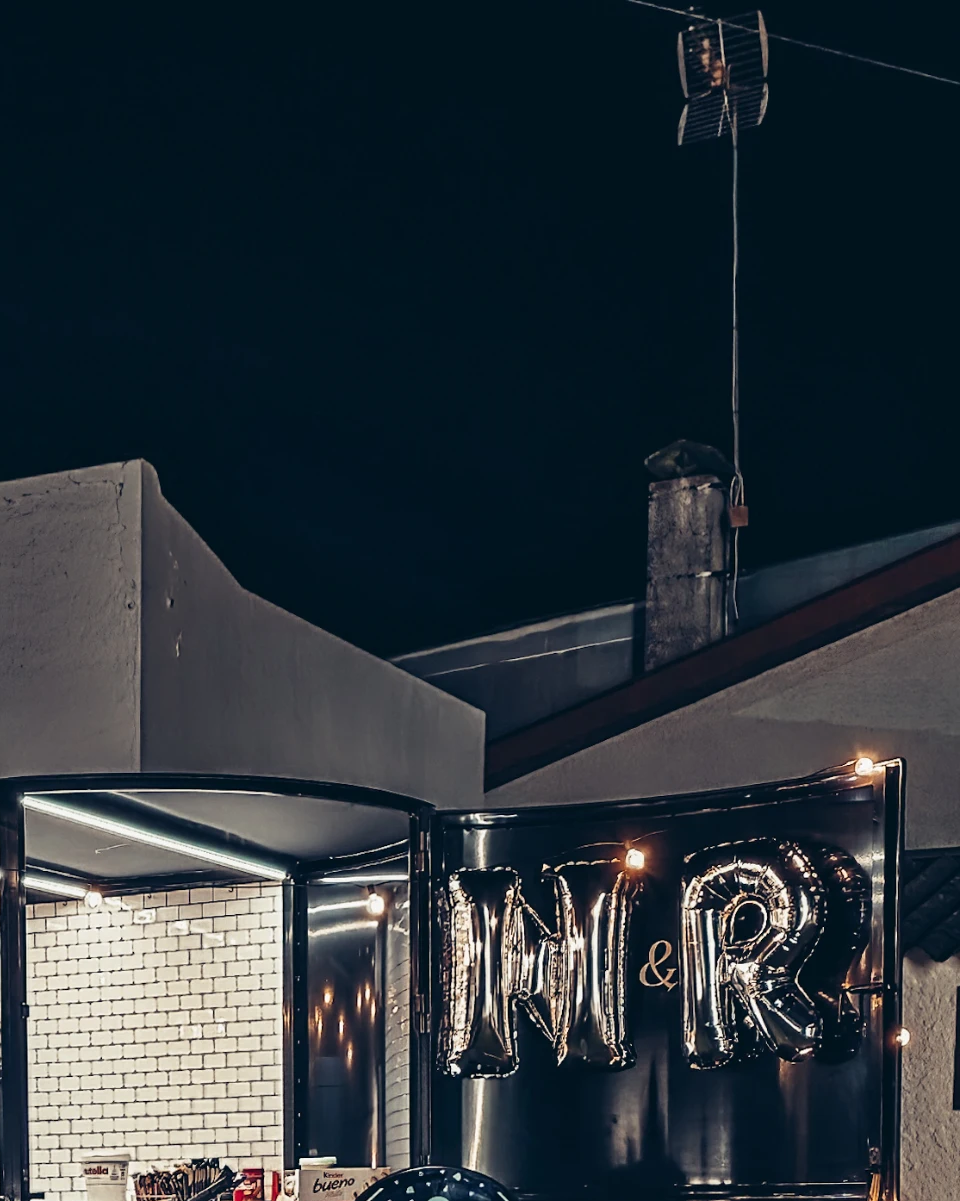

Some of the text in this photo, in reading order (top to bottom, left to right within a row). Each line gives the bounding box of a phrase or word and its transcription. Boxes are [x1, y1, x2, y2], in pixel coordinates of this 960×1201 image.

[437, 836, 826, 1079] N & R
[312, 1178, 355, 1194] bueno
